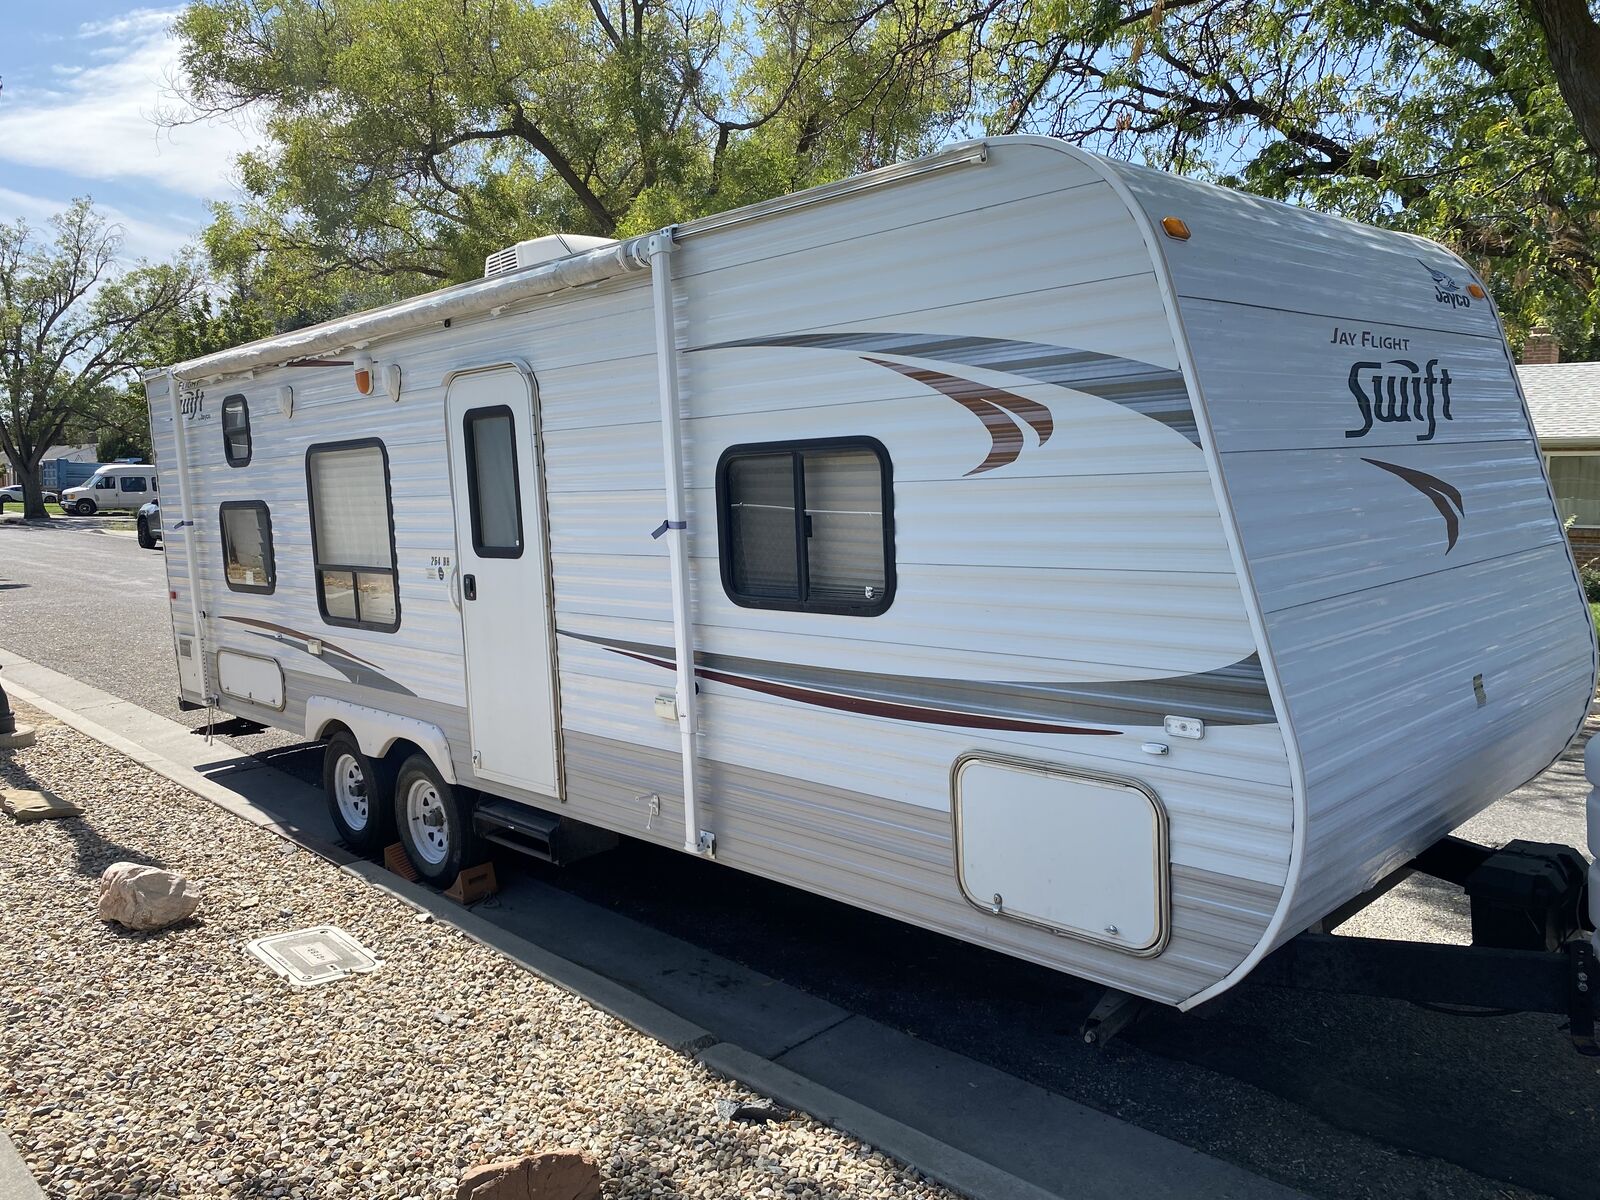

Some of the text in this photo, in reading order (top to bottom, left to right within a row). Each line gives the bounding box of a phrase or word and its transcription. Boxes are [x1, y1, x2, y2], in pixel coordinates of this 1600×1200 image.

[1434, 285, 1471, 309] Jayco
[1330, 327, 1410, 351] JAY FLIGHT
[1345, 358, 1453, 442] Swift
